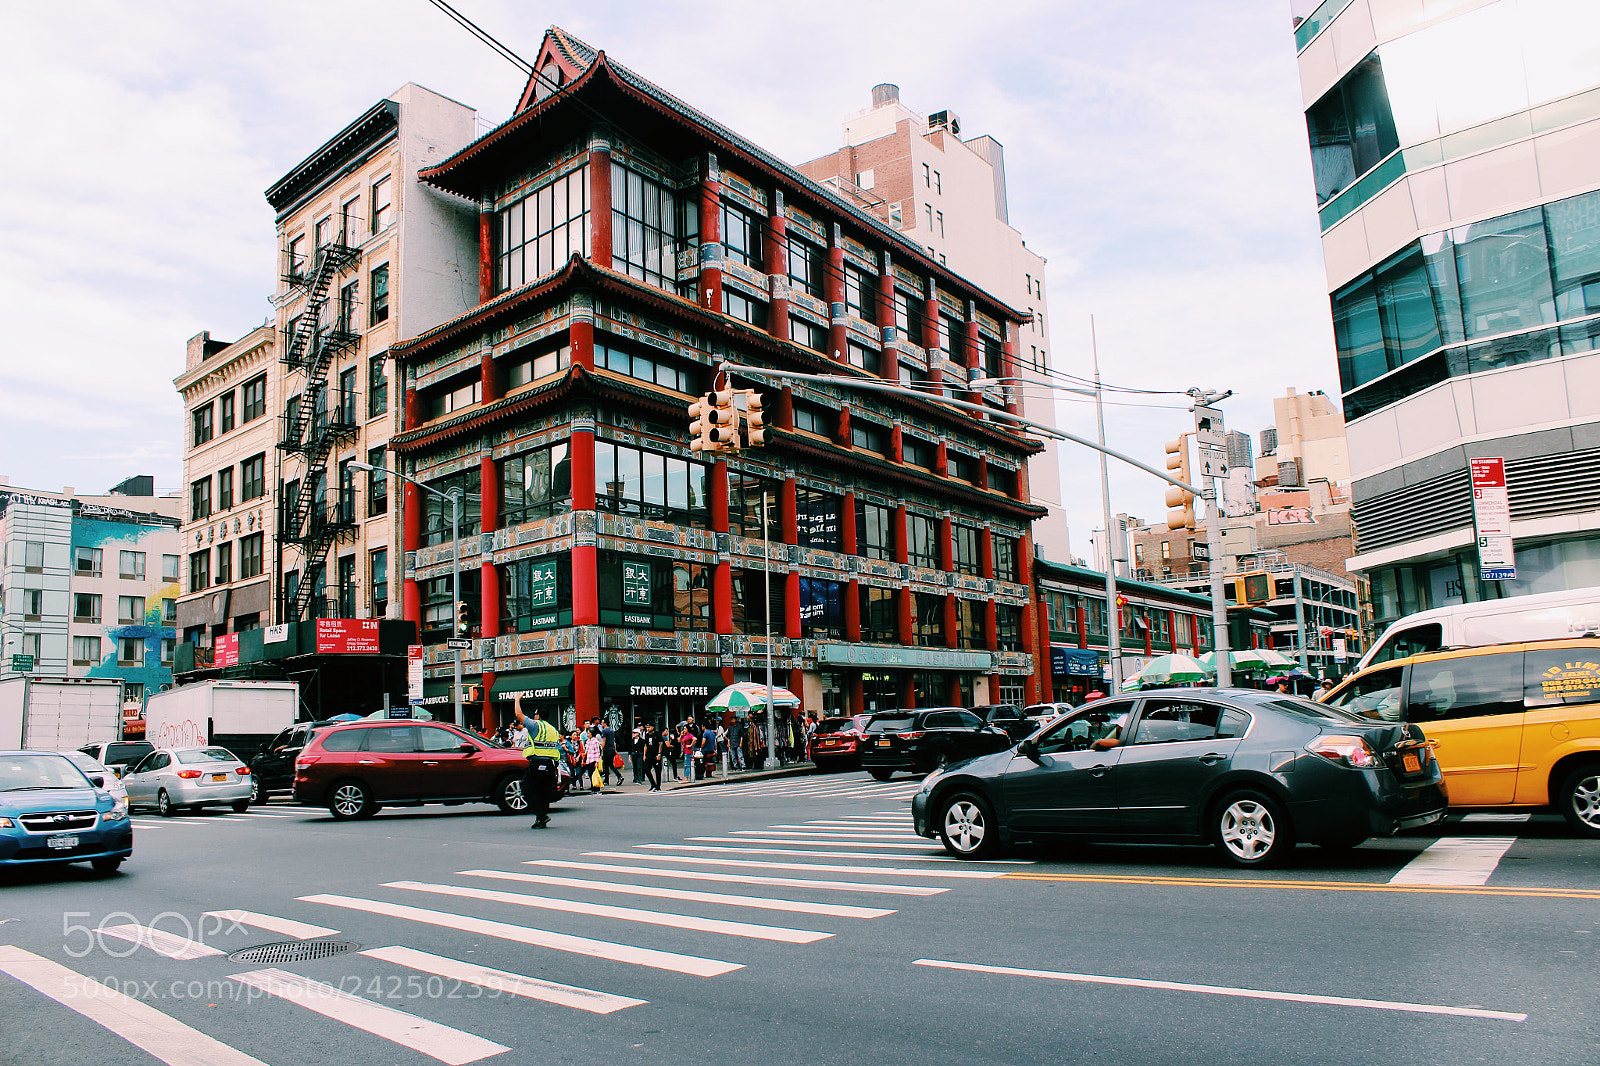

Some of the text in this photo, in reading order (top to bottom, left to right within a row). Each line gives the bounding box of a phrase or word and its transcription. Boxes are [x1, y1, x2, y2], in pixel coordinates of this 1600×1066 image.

[1475, 490, 1481, 499] 3
[1480, 537, 1487, 547] 5
[1196, 547, 1205, 557] ONE
[532, 616, 556, 626] EASTBANK
[624, 615, 651, 624] EASTBANK
[916, 651, 979, 666] EASTBANK
[535, 687, 559, 698] COFFEE
[630, 685, 709, 696] STARBUCKS COFFEE
[422, 695, 449, 705] TARBUCKS
